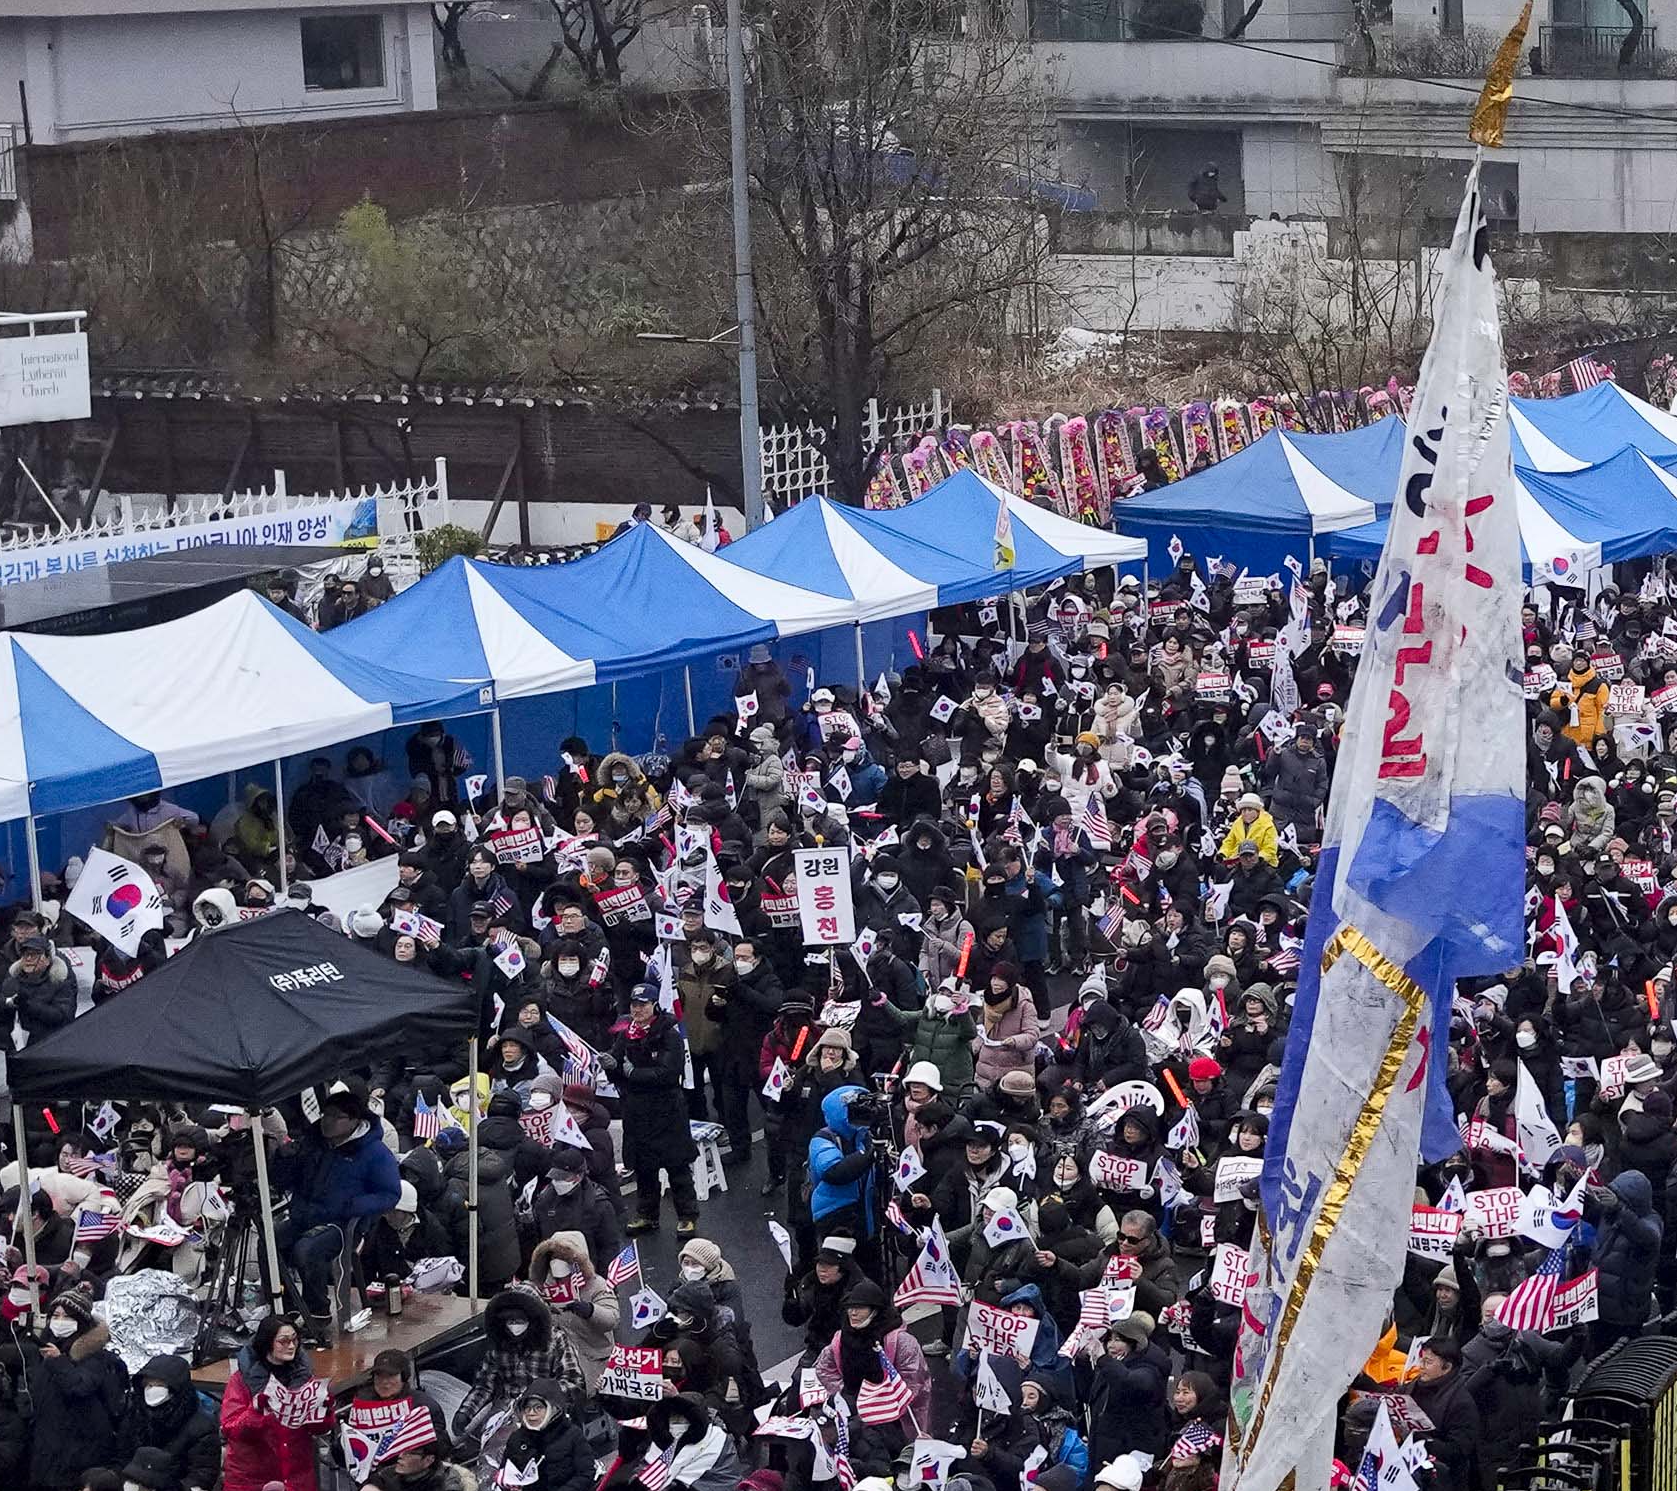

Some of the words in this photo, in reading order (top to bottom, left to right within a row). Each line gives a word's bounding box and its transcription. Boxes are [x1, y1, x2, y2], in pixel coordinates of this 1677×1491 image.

[21, 349, 79, 365] International
[22, 368, 67, 382] Lutheran
[22, 385, 59, 398] Church
[263, 523, 293, 546] 인재
[1612, 687, 1638, 696] STOP
[1615, 696, 1635, 704] THE
[1610, 703, 1640, 713] STEAL
[492, 828, 539, 849] 탄핵반대
[804, 858, 839, 877] 강원
[1620, 861, 1652, 876] 정선거
[814, 885, 840, 941] 홍천
[269, 962, 346, 994] (주)퓨리턴
[519, 1111, 552, 1128] TOP
[1097, 1154, 1139, 1174] STOP
[1101, 1170, 1131, 1188] THE
[1473, 1189, 1523, 1209] STOP
[1412, 1210, 1458, 1234] 핵반대
[1484, 1205, 1519, 1223] THE
[1226, 1269, 1246, 1285] TH
[1212, 1281, 1244, 1303] STE
[976, 1307, 1028, 1335] STOP
[1554, 1295, 1597, 1329] 재명구속
[982, 1321, 1017, 1347] THE
[613, 1346, 661, 1370] 정선거
[614, 1367, 638, 1378] OUT
[277, 1382, 320, 1404] STOP
[603, 1374, 660, 1399] 가짜국회
